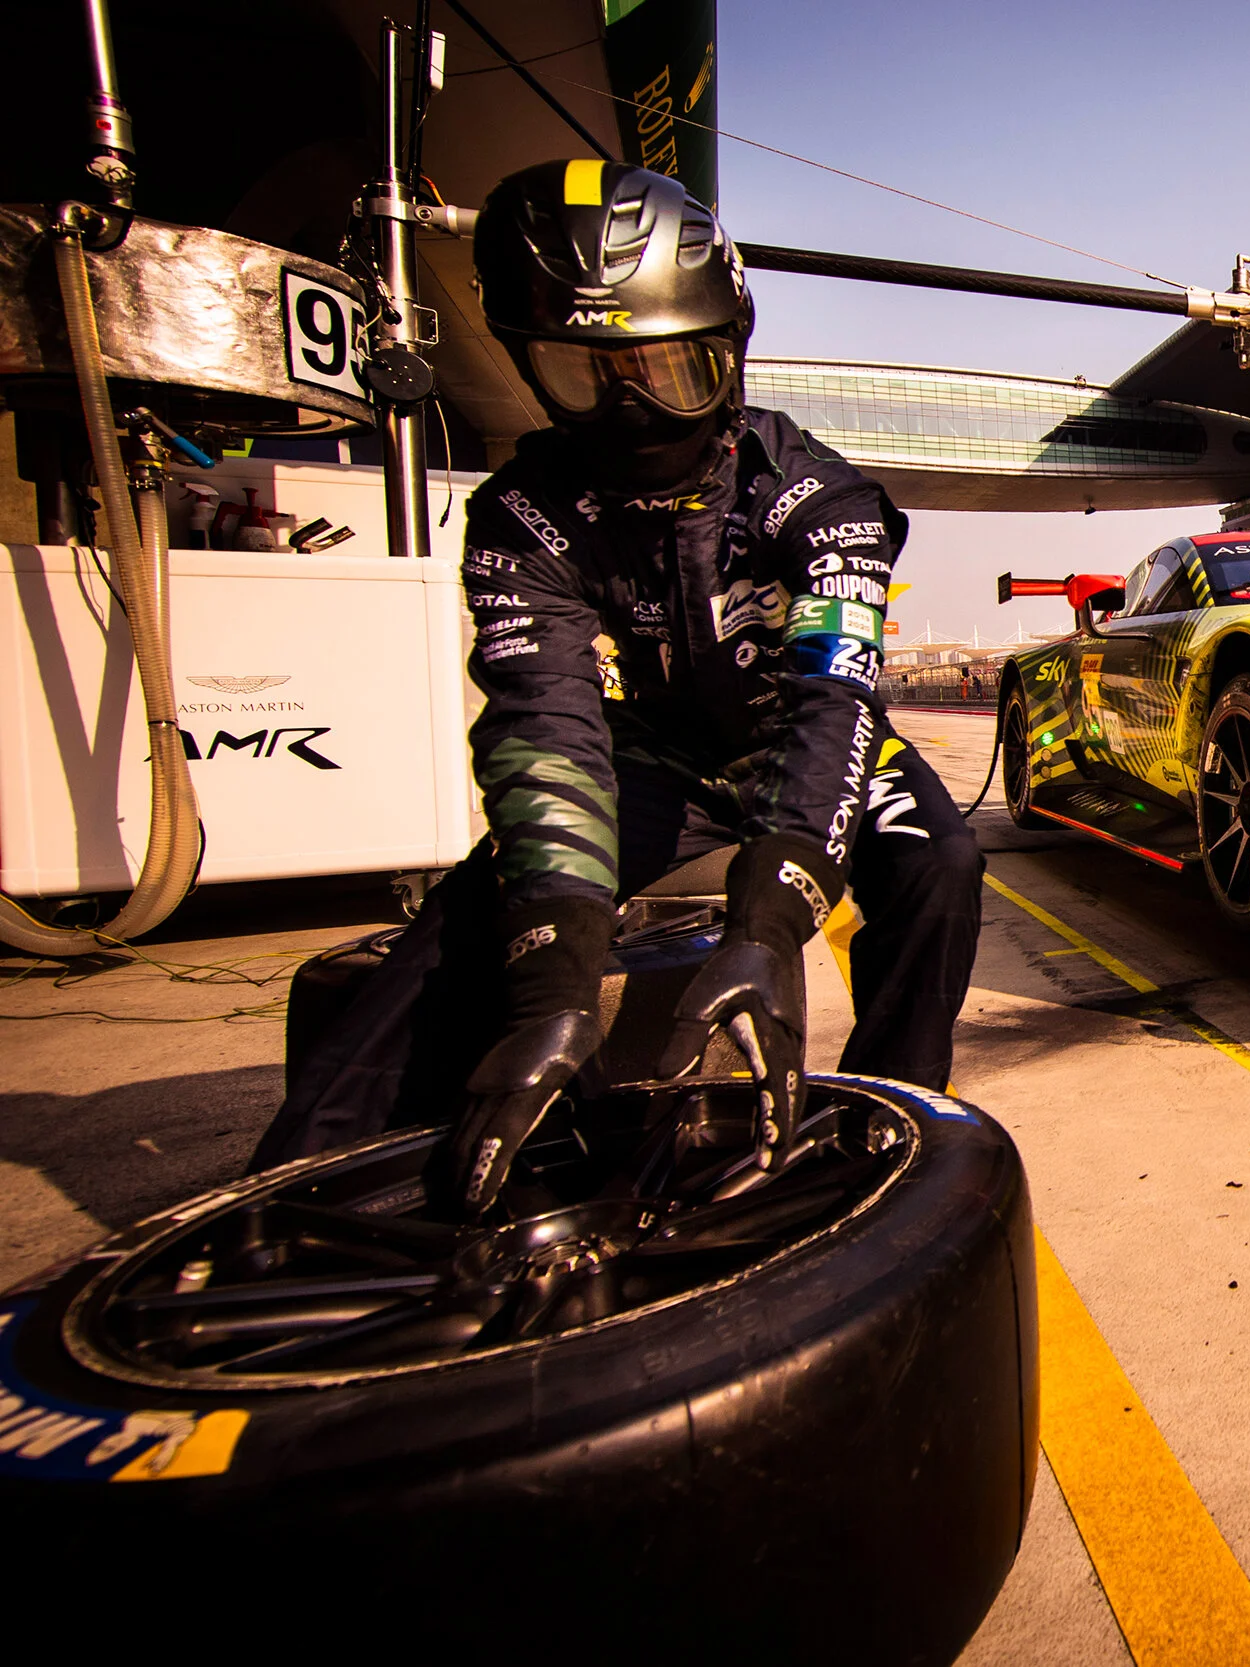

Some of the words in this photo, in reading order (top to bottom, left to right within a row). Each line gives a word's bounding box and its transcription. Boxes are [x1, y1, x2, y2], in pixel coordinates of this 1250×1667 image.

[565, 310, 637, 333] AMR
[763, 477, 824, 538] sparco
[499, 488, 570, 556] sparco
[807, 521, 886, 547] HACKETT
[838, 536, 880, 548] LONDON
[466, 545, 521, 573] CKETT
[1035, 655, 1072, 689] sky
[178, 702, 233, 714] ASTON
[239, 701, 305, 713] MARTIN
[826, 792, 860, 864] STON
